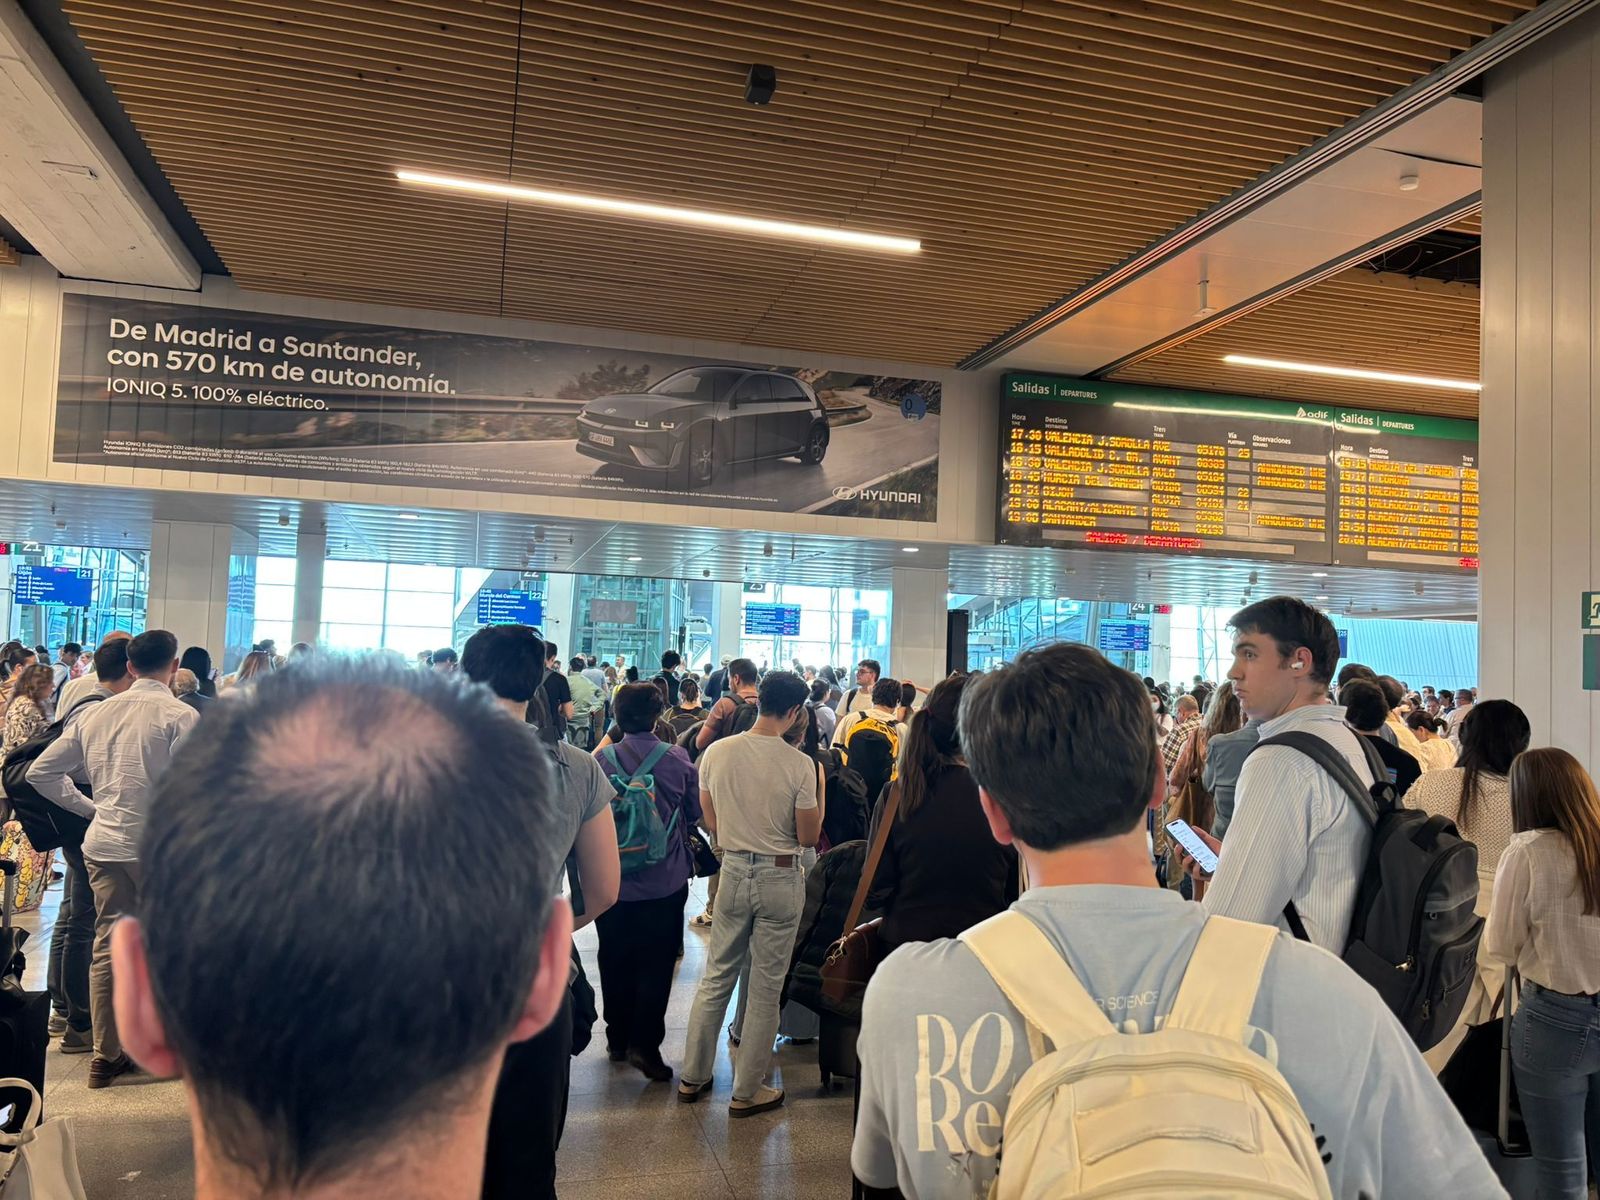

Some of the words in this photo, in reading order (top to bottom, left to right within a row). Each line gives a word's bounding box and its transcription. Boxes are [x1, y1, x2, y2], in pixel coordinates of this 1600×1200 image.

[109, 318, 147, 340] De
[154, 322, 252, 352] Madrid
[258, 337, 276, 354] a
[282, 334, 422, 370] Santander,
[107, 349, 159, 368] con
[166, 350, 216, 374] 570
[223, 354, 265, 379] km
[272, 358, 304, 383] de
[310, 366, 456, 396] autonomía.
[107, 377, 166, 400] IONIQ
[170, 382, 188, 400] 5.
[191, 385, 242, 404] 100%
[247, 391, 329, 411] eléctrico.
[1012, 382, 1050, 395] Salidas
[1060, 390, 1098, 399] DEPARTURES
[905, 399, 912, 410] 0
[1307, 411, 1328, 419] adif
[1341, 413, 1374, 425] Salidas
[1382, 421, 1414, 430] DEPARTURES
[1012, 413, 1026, 421] Hora
[1045, 416, 1068, 425] Destino
[1252, 435, 1291, 445] Observaciones
[1045, 430, 1093, 445] VALENCIA
[1153, 440, 1170, 452] AVE
[1238, 448, 1250, 458] 25
[1045, 444, 1104, 460] VALLADOLID
[1044, 458, 1092, 472] VALENCIA
[1085, 476, 1104, 487] DEL
[1238, 487, 1250, 498] 22
[860, 490, 922, 504] HYUNDAI
[1086, 532, 1128, 545] SALIDAS
[1108, 991, 1159, 1010] SCIENCE
